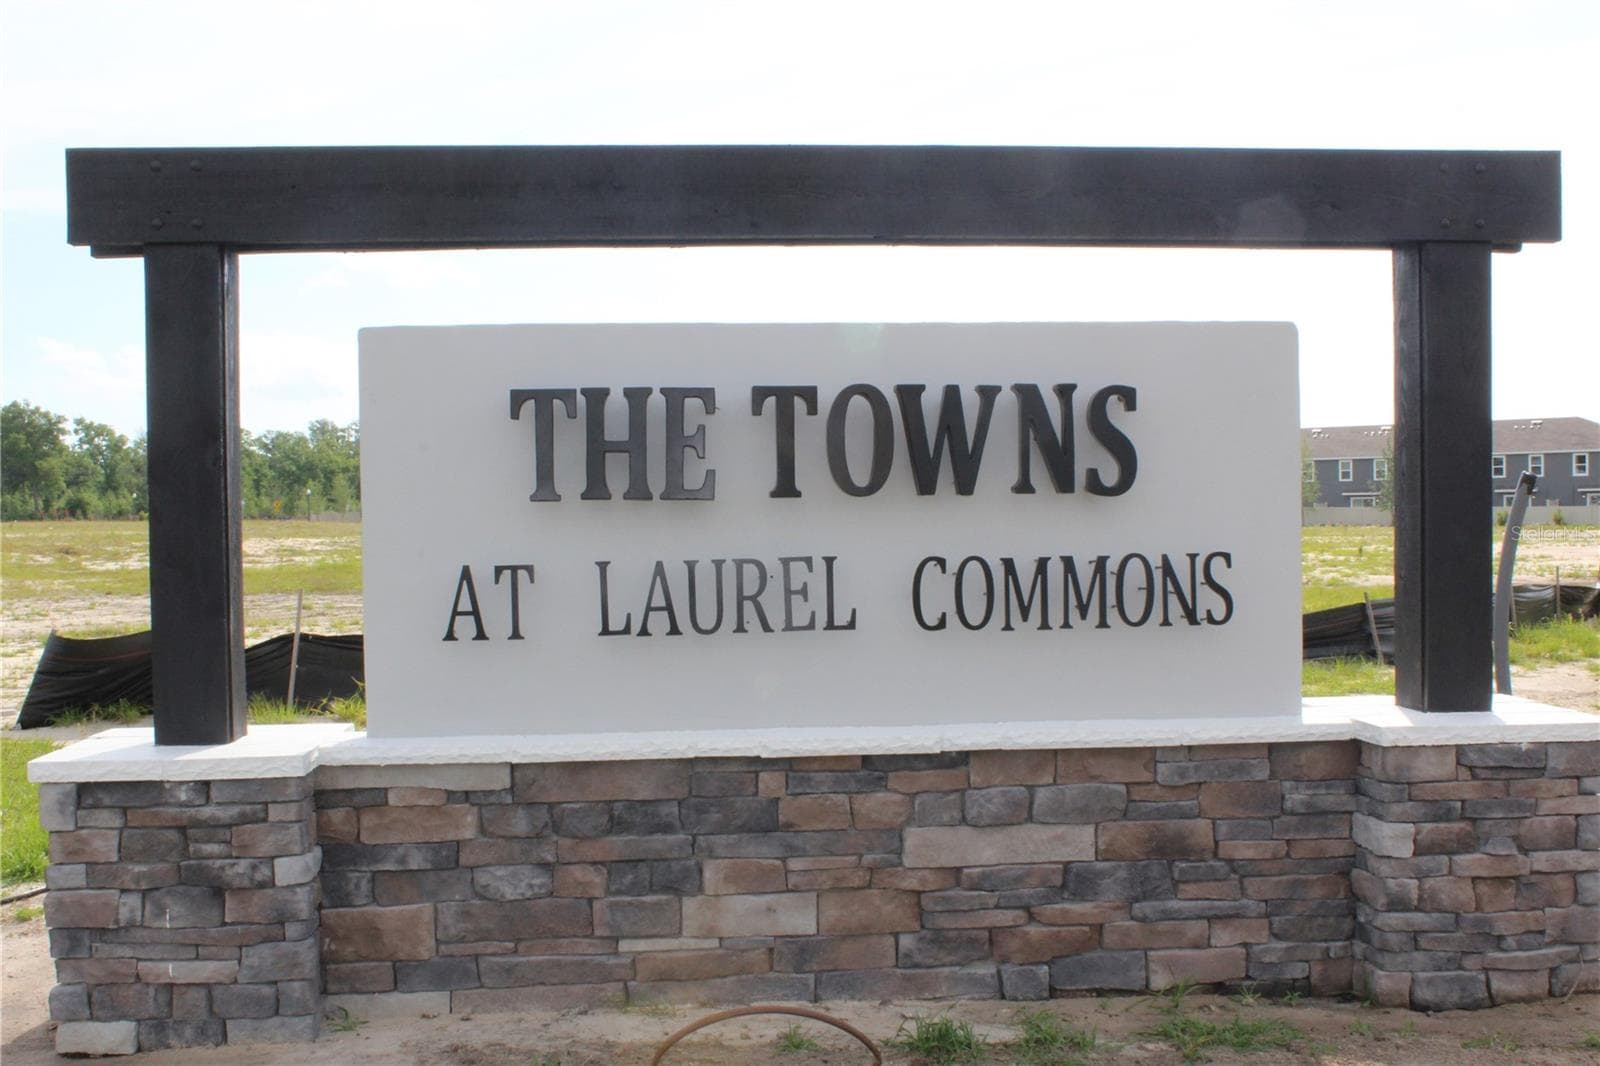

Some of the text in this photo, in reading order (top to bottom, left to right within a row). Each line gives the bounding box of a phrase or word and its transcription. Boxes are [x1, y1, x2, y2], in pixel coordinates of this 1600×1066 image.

[510, 383, 1138, 502] THE TOWNS
[442, 552, 1233, 641] AT LAUREL COMMONS
